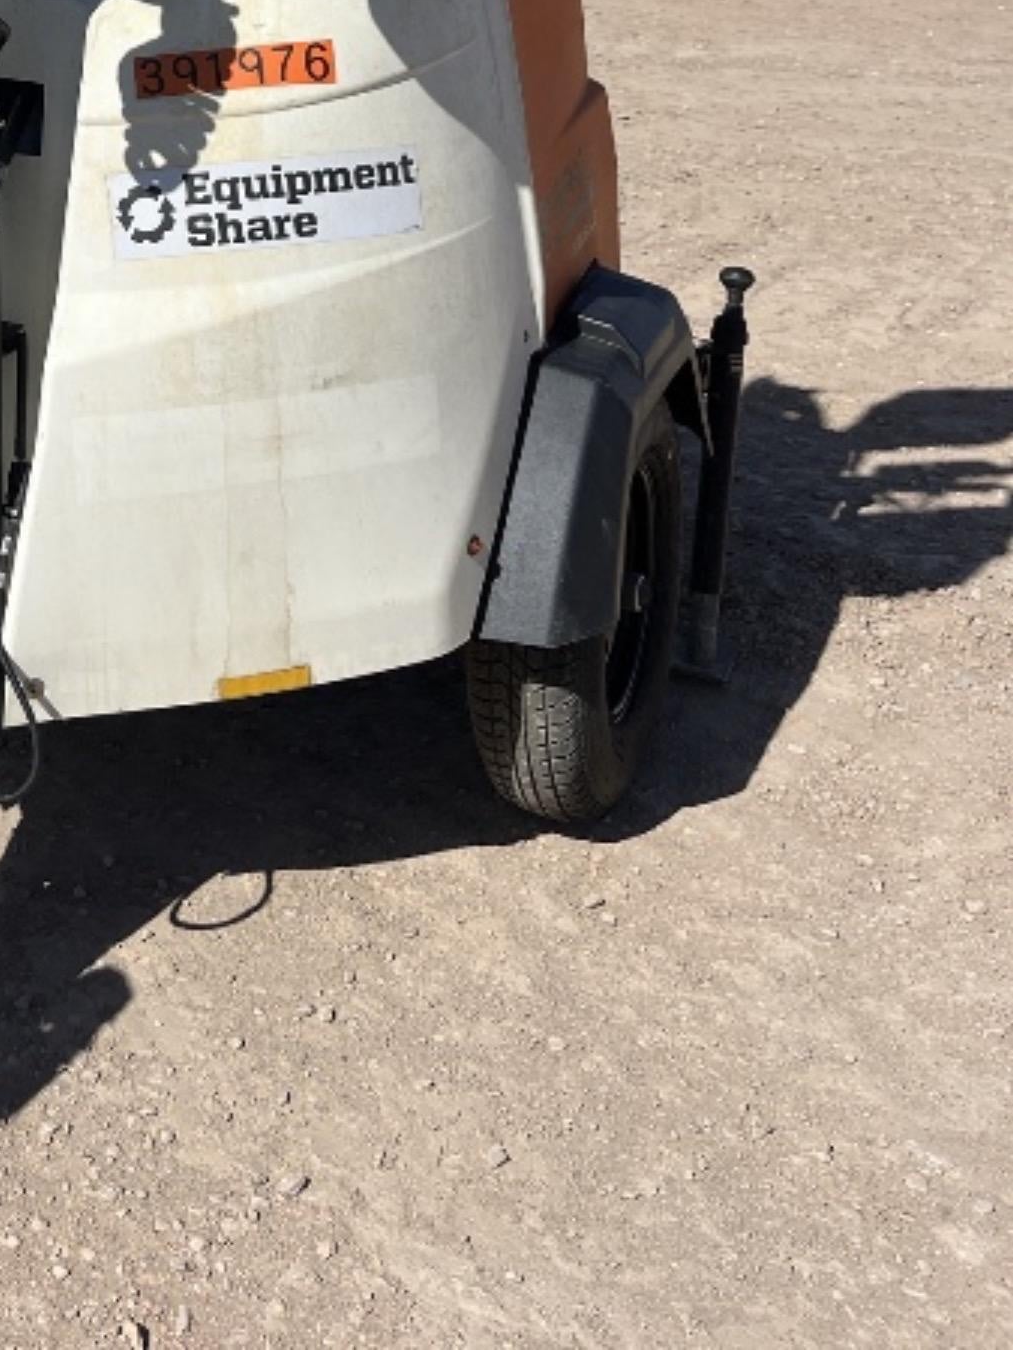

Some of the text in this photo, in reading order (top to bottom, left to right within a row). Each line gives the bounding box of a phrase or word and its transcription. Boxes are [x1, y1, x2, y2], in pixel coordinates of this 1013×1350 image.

[138, 41, 331, 96] 391976
[182, 153, 417, 210] Equipment
[186, 211, 320, 247] Share
